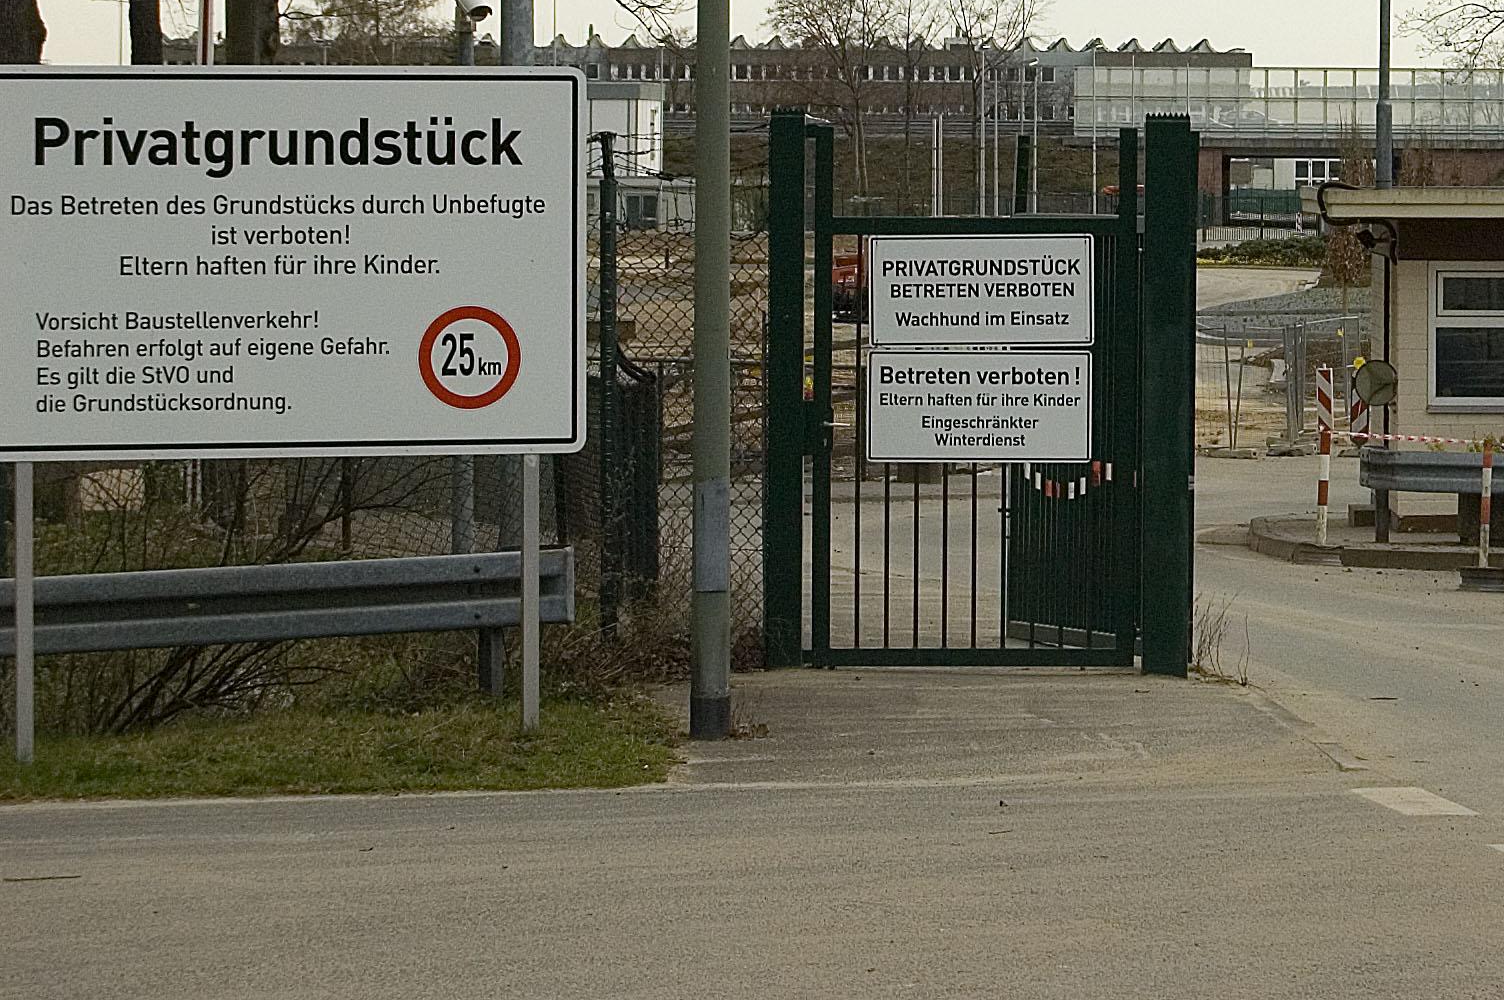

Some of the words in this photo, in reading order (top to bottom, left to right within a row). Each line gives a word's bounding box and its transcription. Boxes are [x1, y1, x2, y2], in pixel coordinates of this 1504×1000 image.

[33, 116, 523, 178] Privatgrundstück
[10, 195, 53, 216] Das
[61, 195, 158, 216] Betreten
[167, 195, 205, 216] des
[213, 194, 354, 215] Grundstücks
[362, 194, 424, 215] durch
[432, 194, 546, 219] Unbefugte
[211, 225, 237, 247] ist
[244, 225, 351, 247] verboten!
[120, 256, 188, 277] Eltern
[196, 255, 265, 276] haften
[274, 255, 306, 276] für
[313, 255, 356, 275] ihre
[364, 254, 441, 275] Kinder.
[882, 255, 1080, 277] PRIVATGRUNDSTÜCK
[891, 284, 979, 298] BETRETEN
[984, 282, 1074, 297] VERBOTEN
[36, 310, 118, 331] Vorsicht
[125, 310, 319, 331] Baustellenverkehr!
[896, 312, 979, 327] Wachhund
[985, 312, 1005, 326] im
[1011, 311, 1069, 326] Einsatz
[37, 338, 129, 358] Befahren
[136, 338, 203, 361] erfolgt
[210, 338, 241, 357] auf
[248, 339, 313, 361] eigene
[321, 338, 391, 356] Gefahr.
[441, 333, 475, 377] 25
[478, 358, 502, 377] km
[37, 368, 61, 385] Es
[68, 367, 98, 389] gilt
[105, 367, 135, 384] die
[142, 367, 189, 384] StVO
[197, 366, 234, 384] und
[880, 366, 970, 385] Betreten
[977, 366, 1069, 385] verboten
[36, 394, 66, 413] die
[73, 392, 292, 415] Grundstücksordnung.
[879, 393, 923, 406] Eltern
[928, 394, 972, 406] haften
[976, 394, 997, 406] für
[1001, 394, 1029, 407] ihre
[1033, 394, 1080, 407] Kinder
[922, 416, 1039, 431] Eingeschränkter
[935, 433, 1025, 447] Winterdienst
